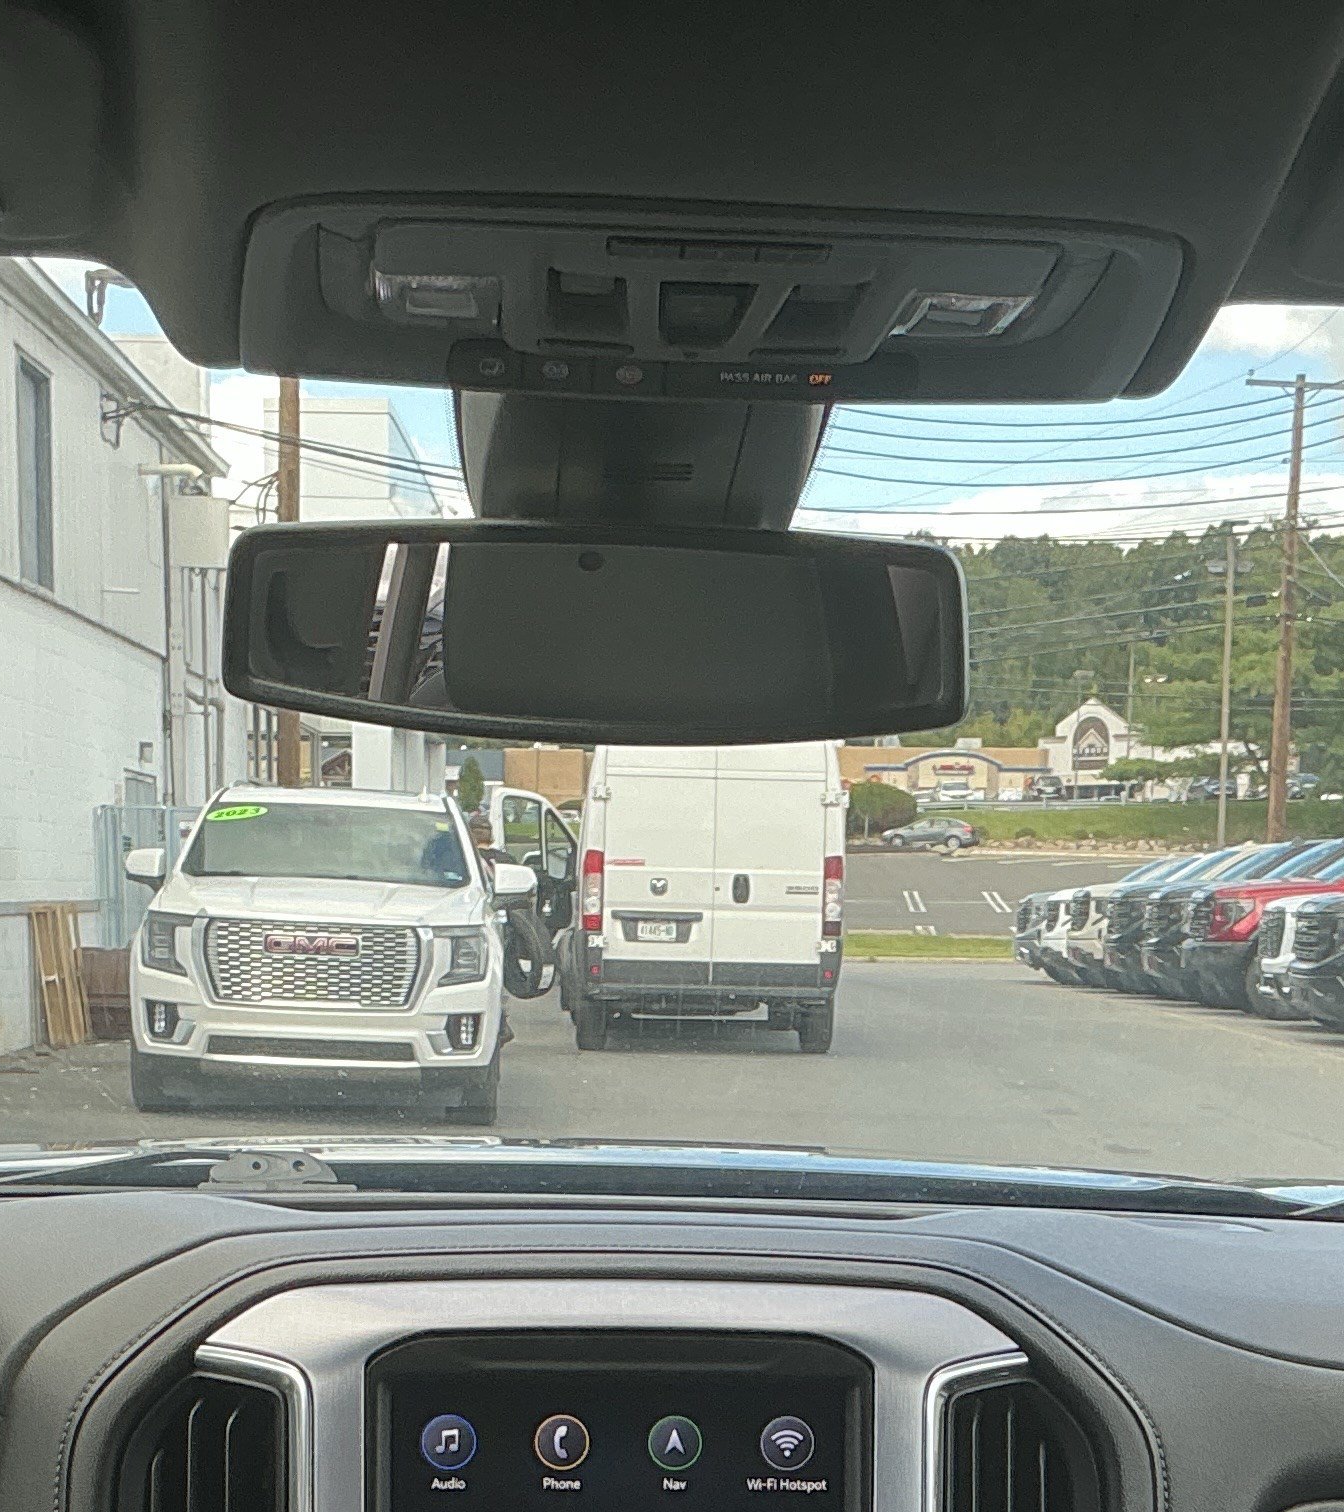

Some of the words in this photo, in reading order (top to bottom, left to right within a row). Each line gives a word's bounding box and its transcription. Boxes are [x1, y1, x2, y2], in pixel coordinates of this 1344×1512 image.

[808, 373, 832, 385] OFF
[265, 932, 359, 956] GMC
[431, 1477, 466, 1490] Audio
[542, 1477, 581, 1491] Phone
[663, 1478, 687, 1490] Nav
[746, 1478, 778, 1491] Wi-Fi
[779, 1478, 827, 1493] Hotspot
